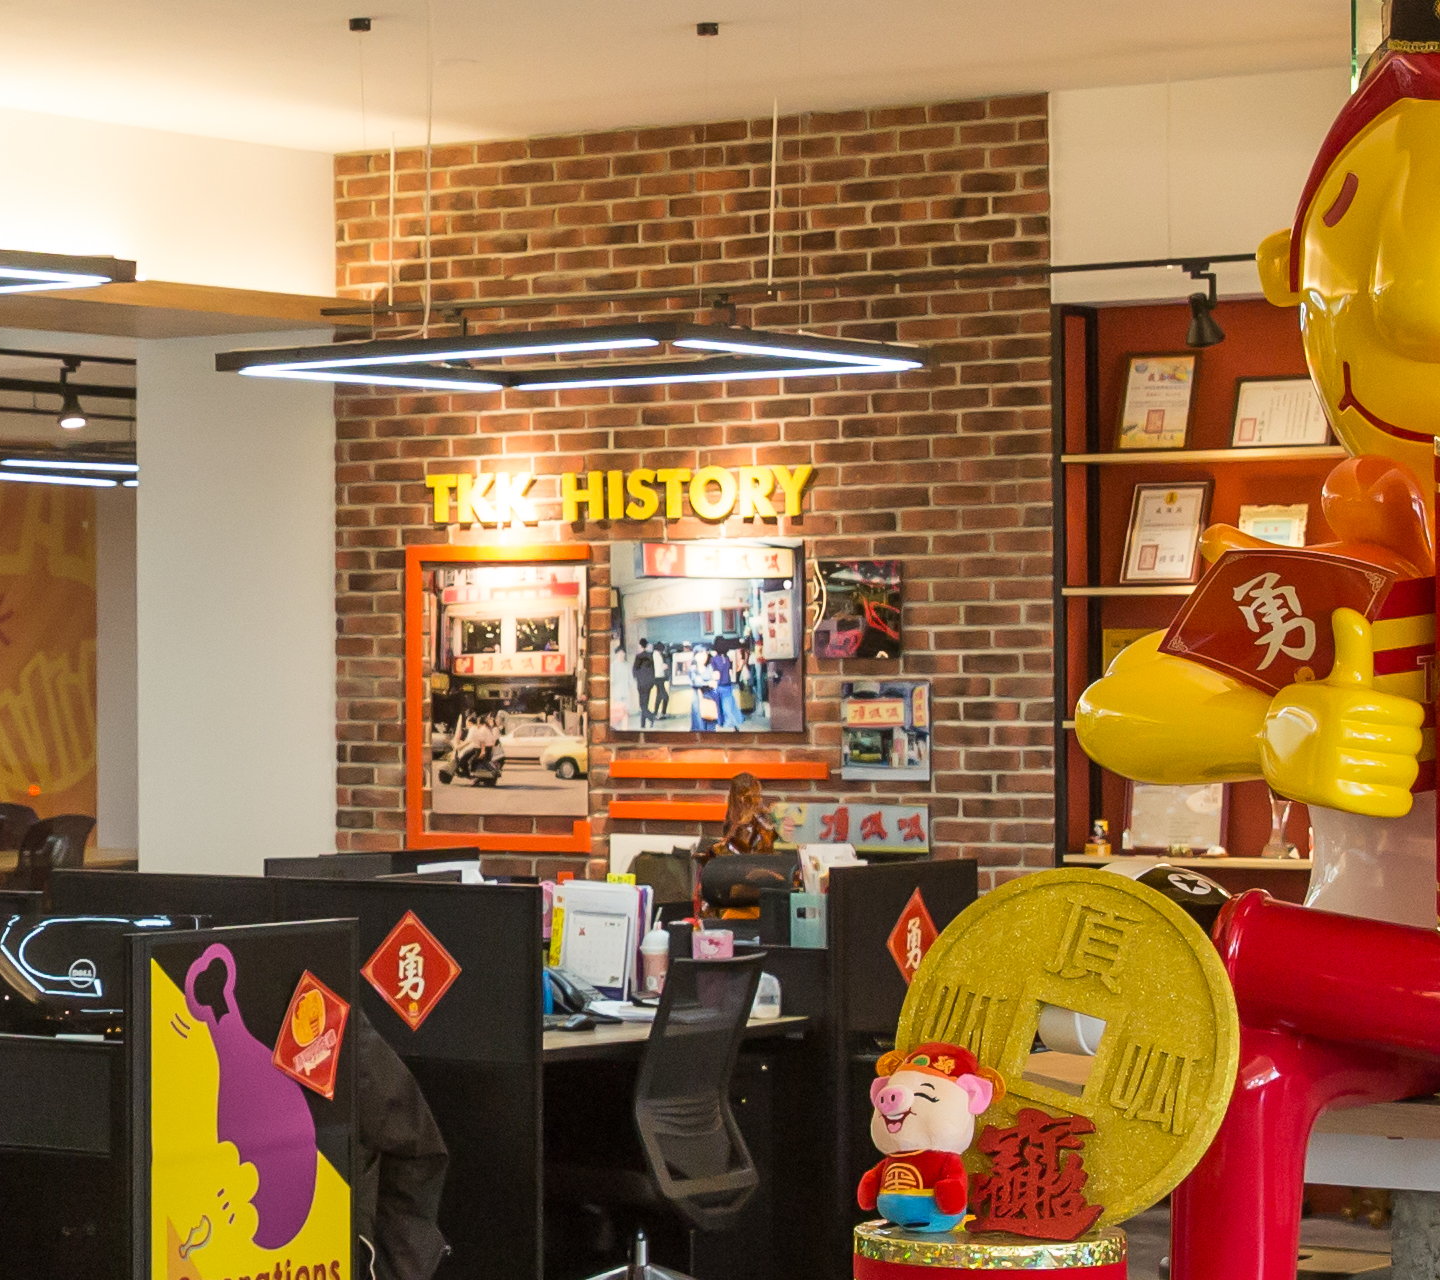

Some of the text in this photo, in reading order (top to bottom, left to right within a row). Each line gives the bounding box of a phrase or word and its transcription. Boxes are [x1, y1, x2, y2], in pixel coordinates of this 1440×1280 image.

[425, 464, 816, 527] TKK HISTORY
[1232, 572, 1316, 670] 勇
[393, 941, 424, 1001] 勇
[905, 916, 922, 970] 勇
[1044, 897, 1142, 995] 頂
